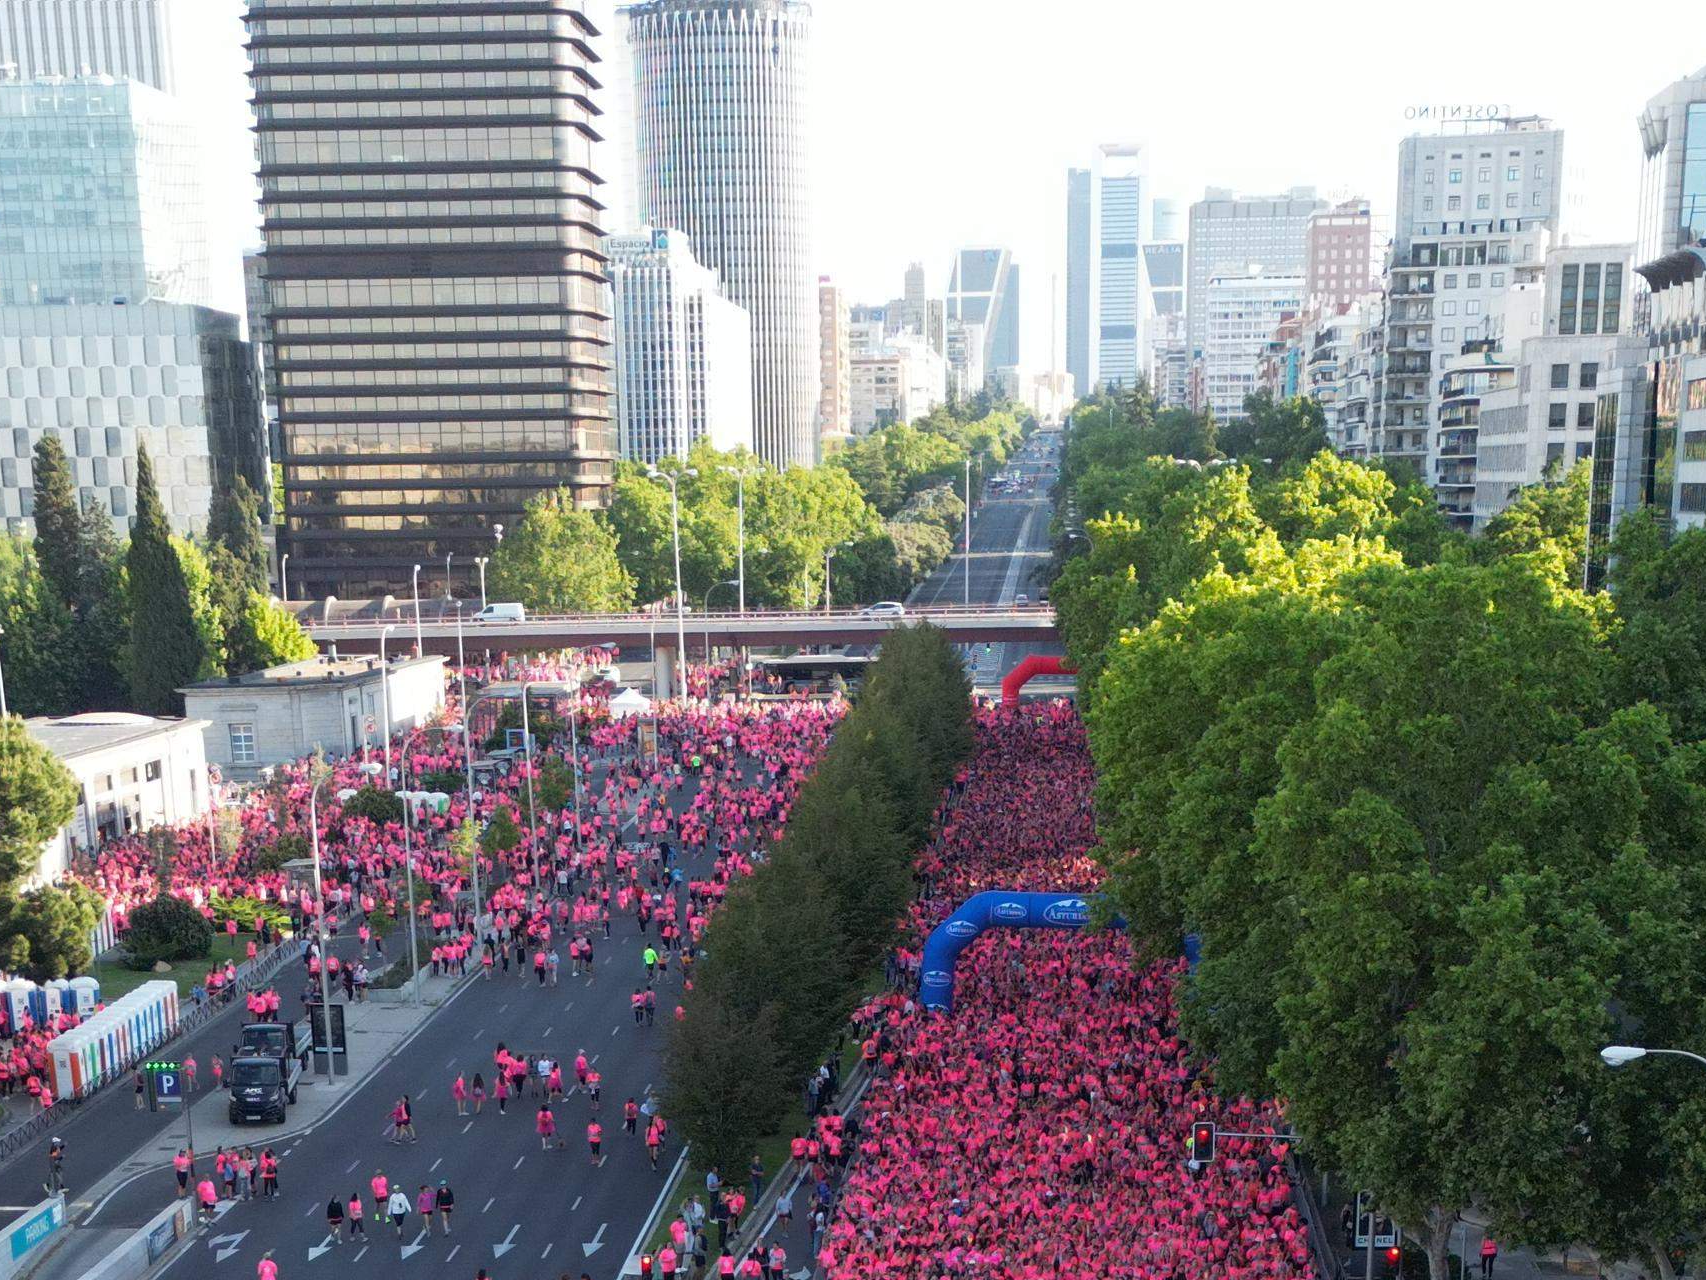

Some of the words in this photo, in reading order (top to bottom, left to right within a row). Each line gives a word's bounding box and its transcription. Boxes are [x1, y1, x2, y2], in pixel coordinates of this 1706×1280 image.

[610, 239, 649, 250] Espacio
[163, 1076, 174, 1094] P
[1356, 1236, 1394, 1245] CHNEL
